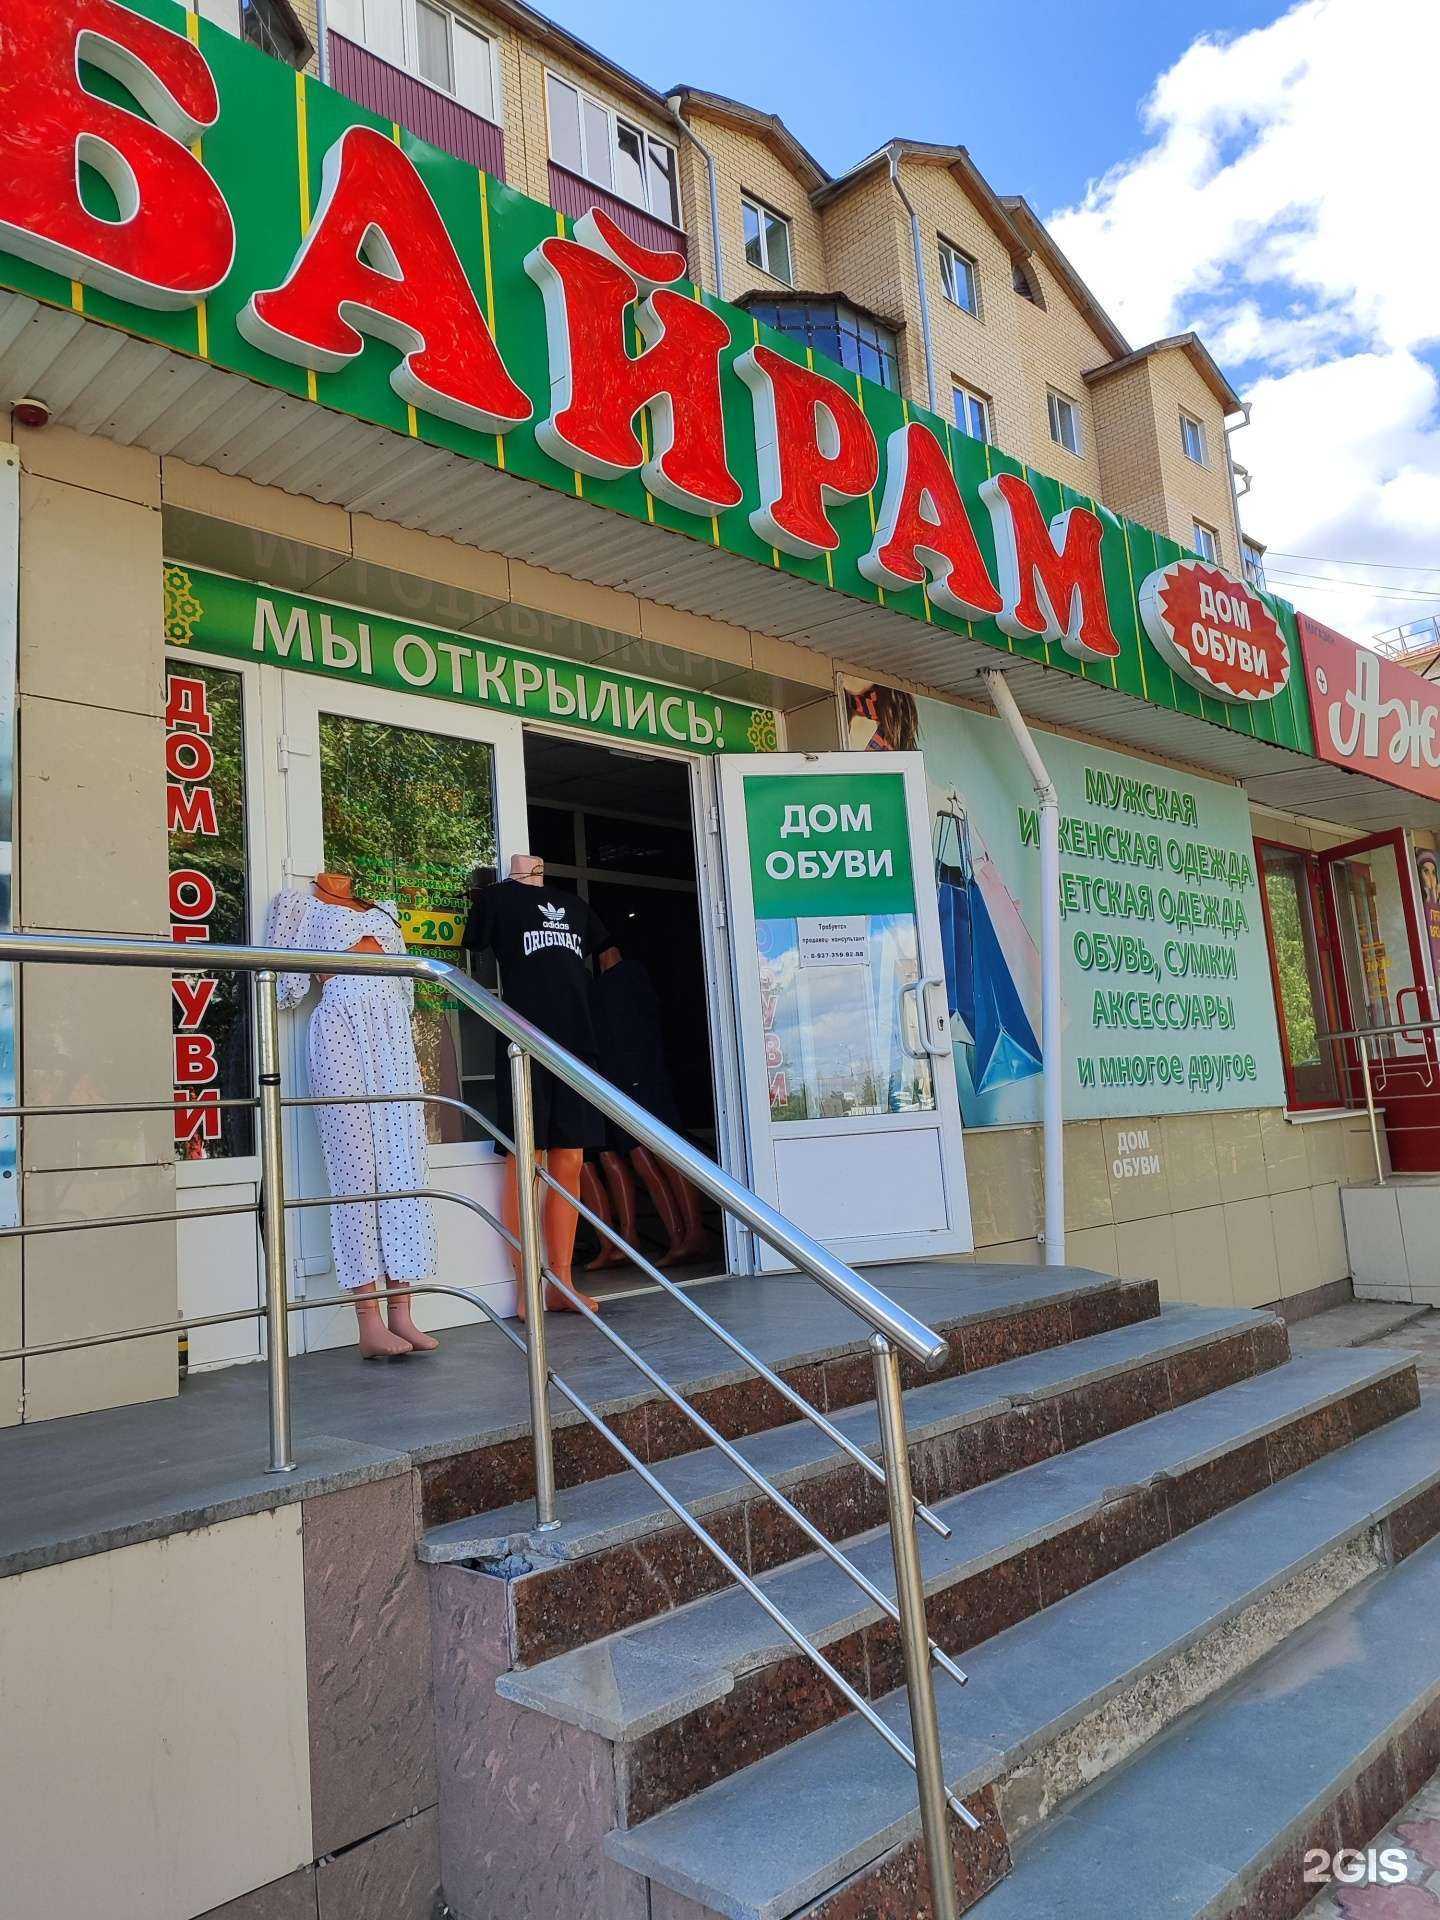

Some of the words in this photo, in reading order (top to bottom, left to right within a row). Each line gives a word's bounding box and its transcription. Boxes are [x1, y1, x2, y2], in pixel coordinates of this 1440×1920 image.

[0, 0, 1120, 663] БАЙРАМ
[1199, 581, 1252, 633] ДОМ
[251, 596, 374, 676] МЫ
[392, 634, 725, 747] ОТКРЫЛИСЬ!
[1191, 622, 1270, 680] ОБУВИ
[165, 674, 219, 836] ДОМ
[780, 803, 873, 839] ДОМ
[1084, 767, 1199, 828] МУЖСКАЯ
[765, 849, 894, 881] ОБУВИ
[1017, 804, 1041, 848] И
[1166, 837, 1256, 894] ОДЕЖДА
[542, 921, 570, 930] adidas
[1059, 871, 1154, 921] ЕТСКАЯ
[1157, 887, 1250, 940] ОДЕЖДА
[1073, 929, 1162, 983] ОБУВЬ,
[1163, 939, 1239, 980] СУМКИ
[1092, 989, 1236, 1030] АКСЕССУАРЫ
[1076, 1056, 1096, 1088] и
[1099, 1054, 1185, 1087] многое
[1187, 1053, 1258, 1093] другое
[1112, 1154, 1161, 1179] ОБУВИ
[1117, 1130, 1151, 1155] ДОМ
